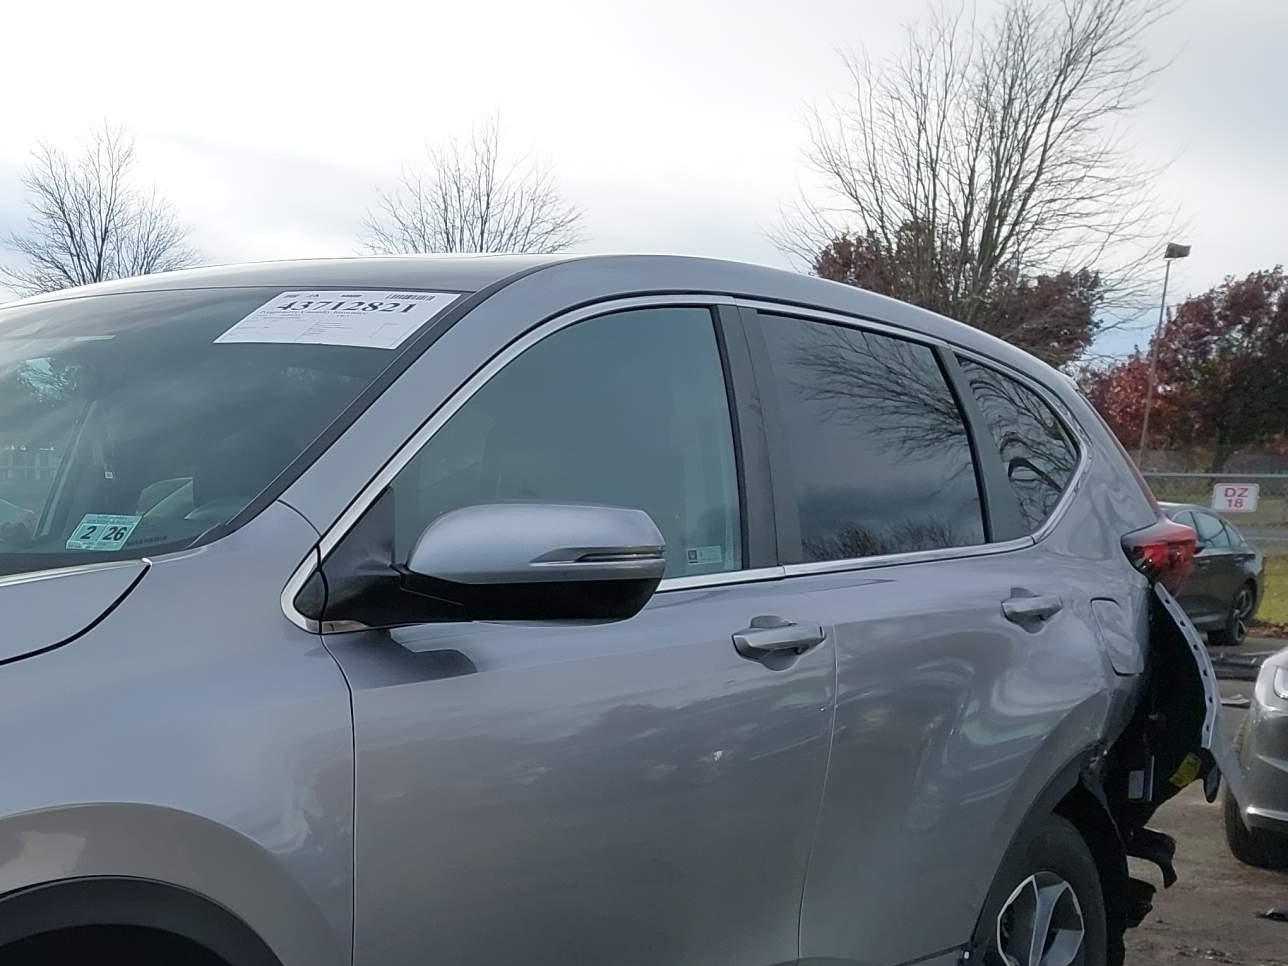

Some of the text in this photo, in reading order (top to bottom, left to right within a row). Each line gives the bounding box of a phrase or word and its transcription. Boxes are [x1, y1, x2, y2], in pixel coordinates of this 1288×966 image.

[277, 300, 417, 313] 43712821
[1224, 487, 1249, 498] DZ
[1226, 498, 1244, 508] 18
[80, 525, 97, 540] 2
[103, 526, 128, 541] 26
